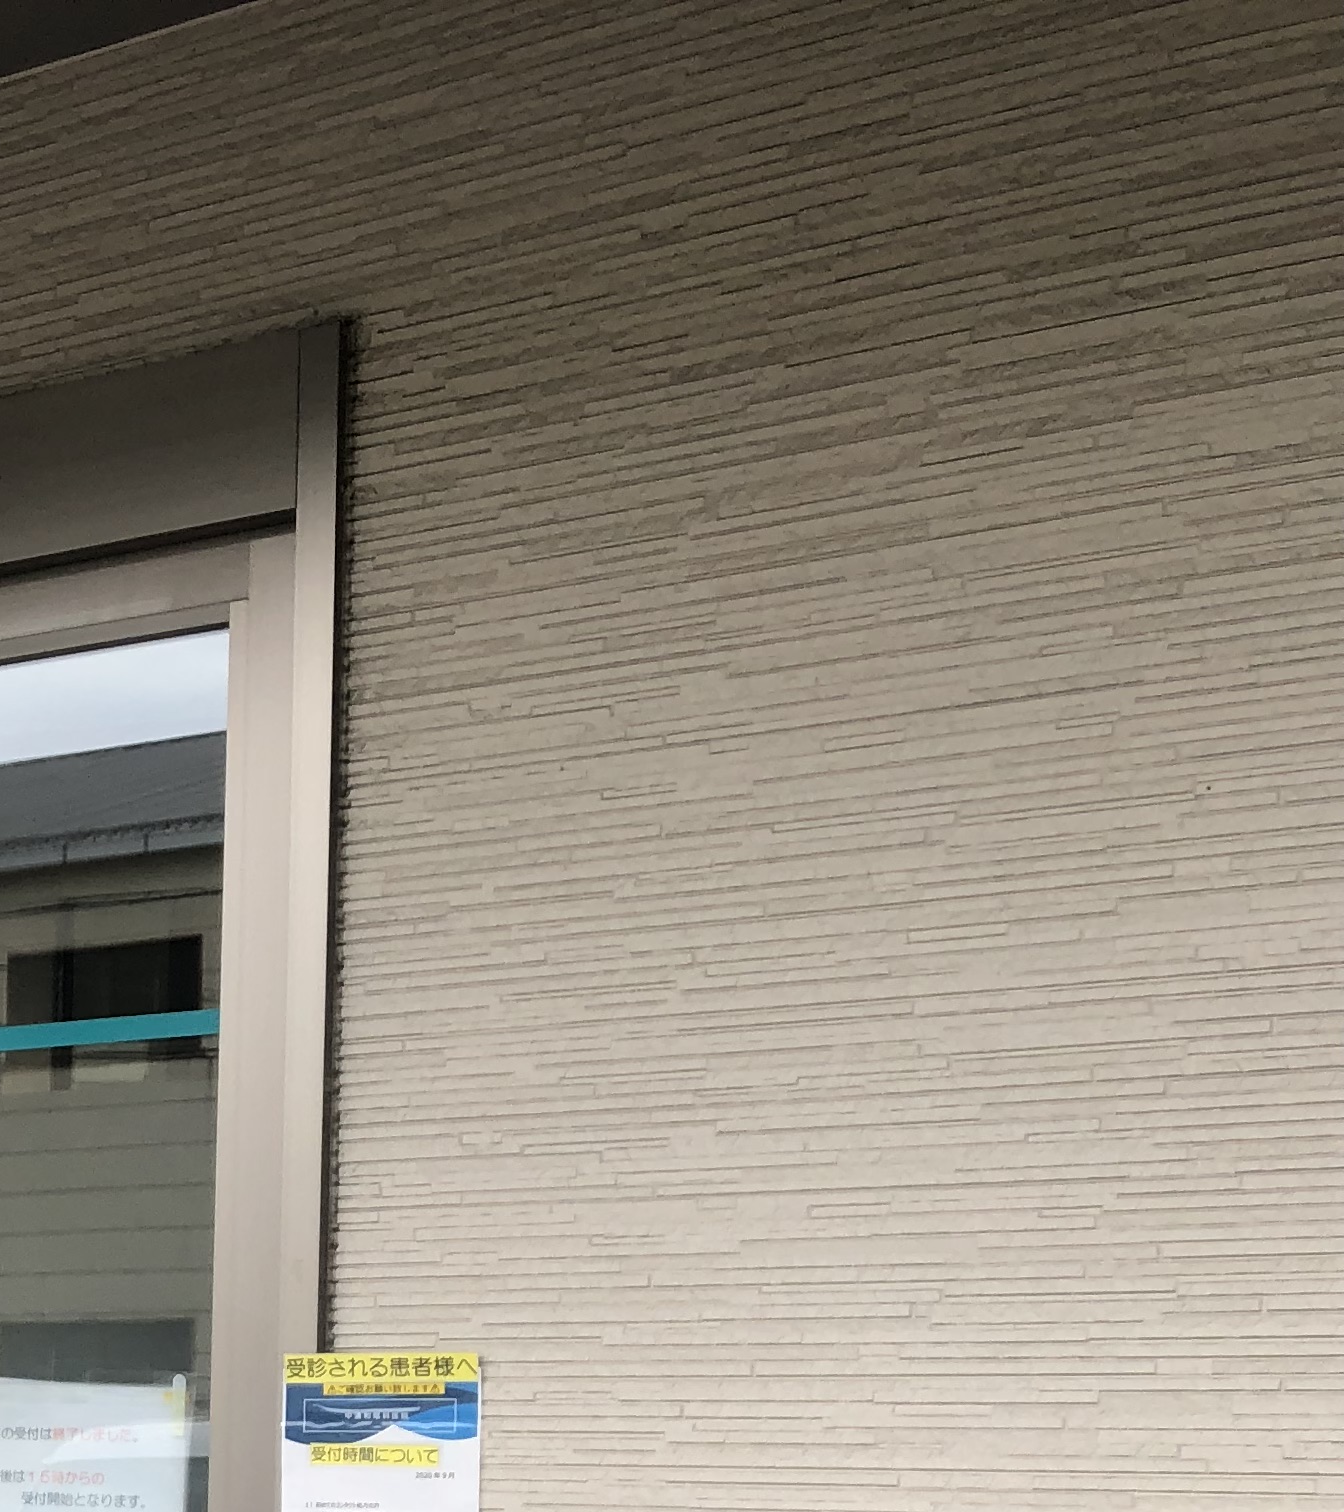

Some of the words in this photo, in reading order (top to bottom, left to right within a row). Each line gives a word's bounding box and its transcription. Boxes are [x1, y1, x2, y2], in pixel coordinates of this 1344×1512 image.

[287, 1357, 477, 1378] 受診される患者様へ
[311, 1446, 437, 1463] 受付時間について
[21, 1492, 147, 1509] 受付開始となります。
